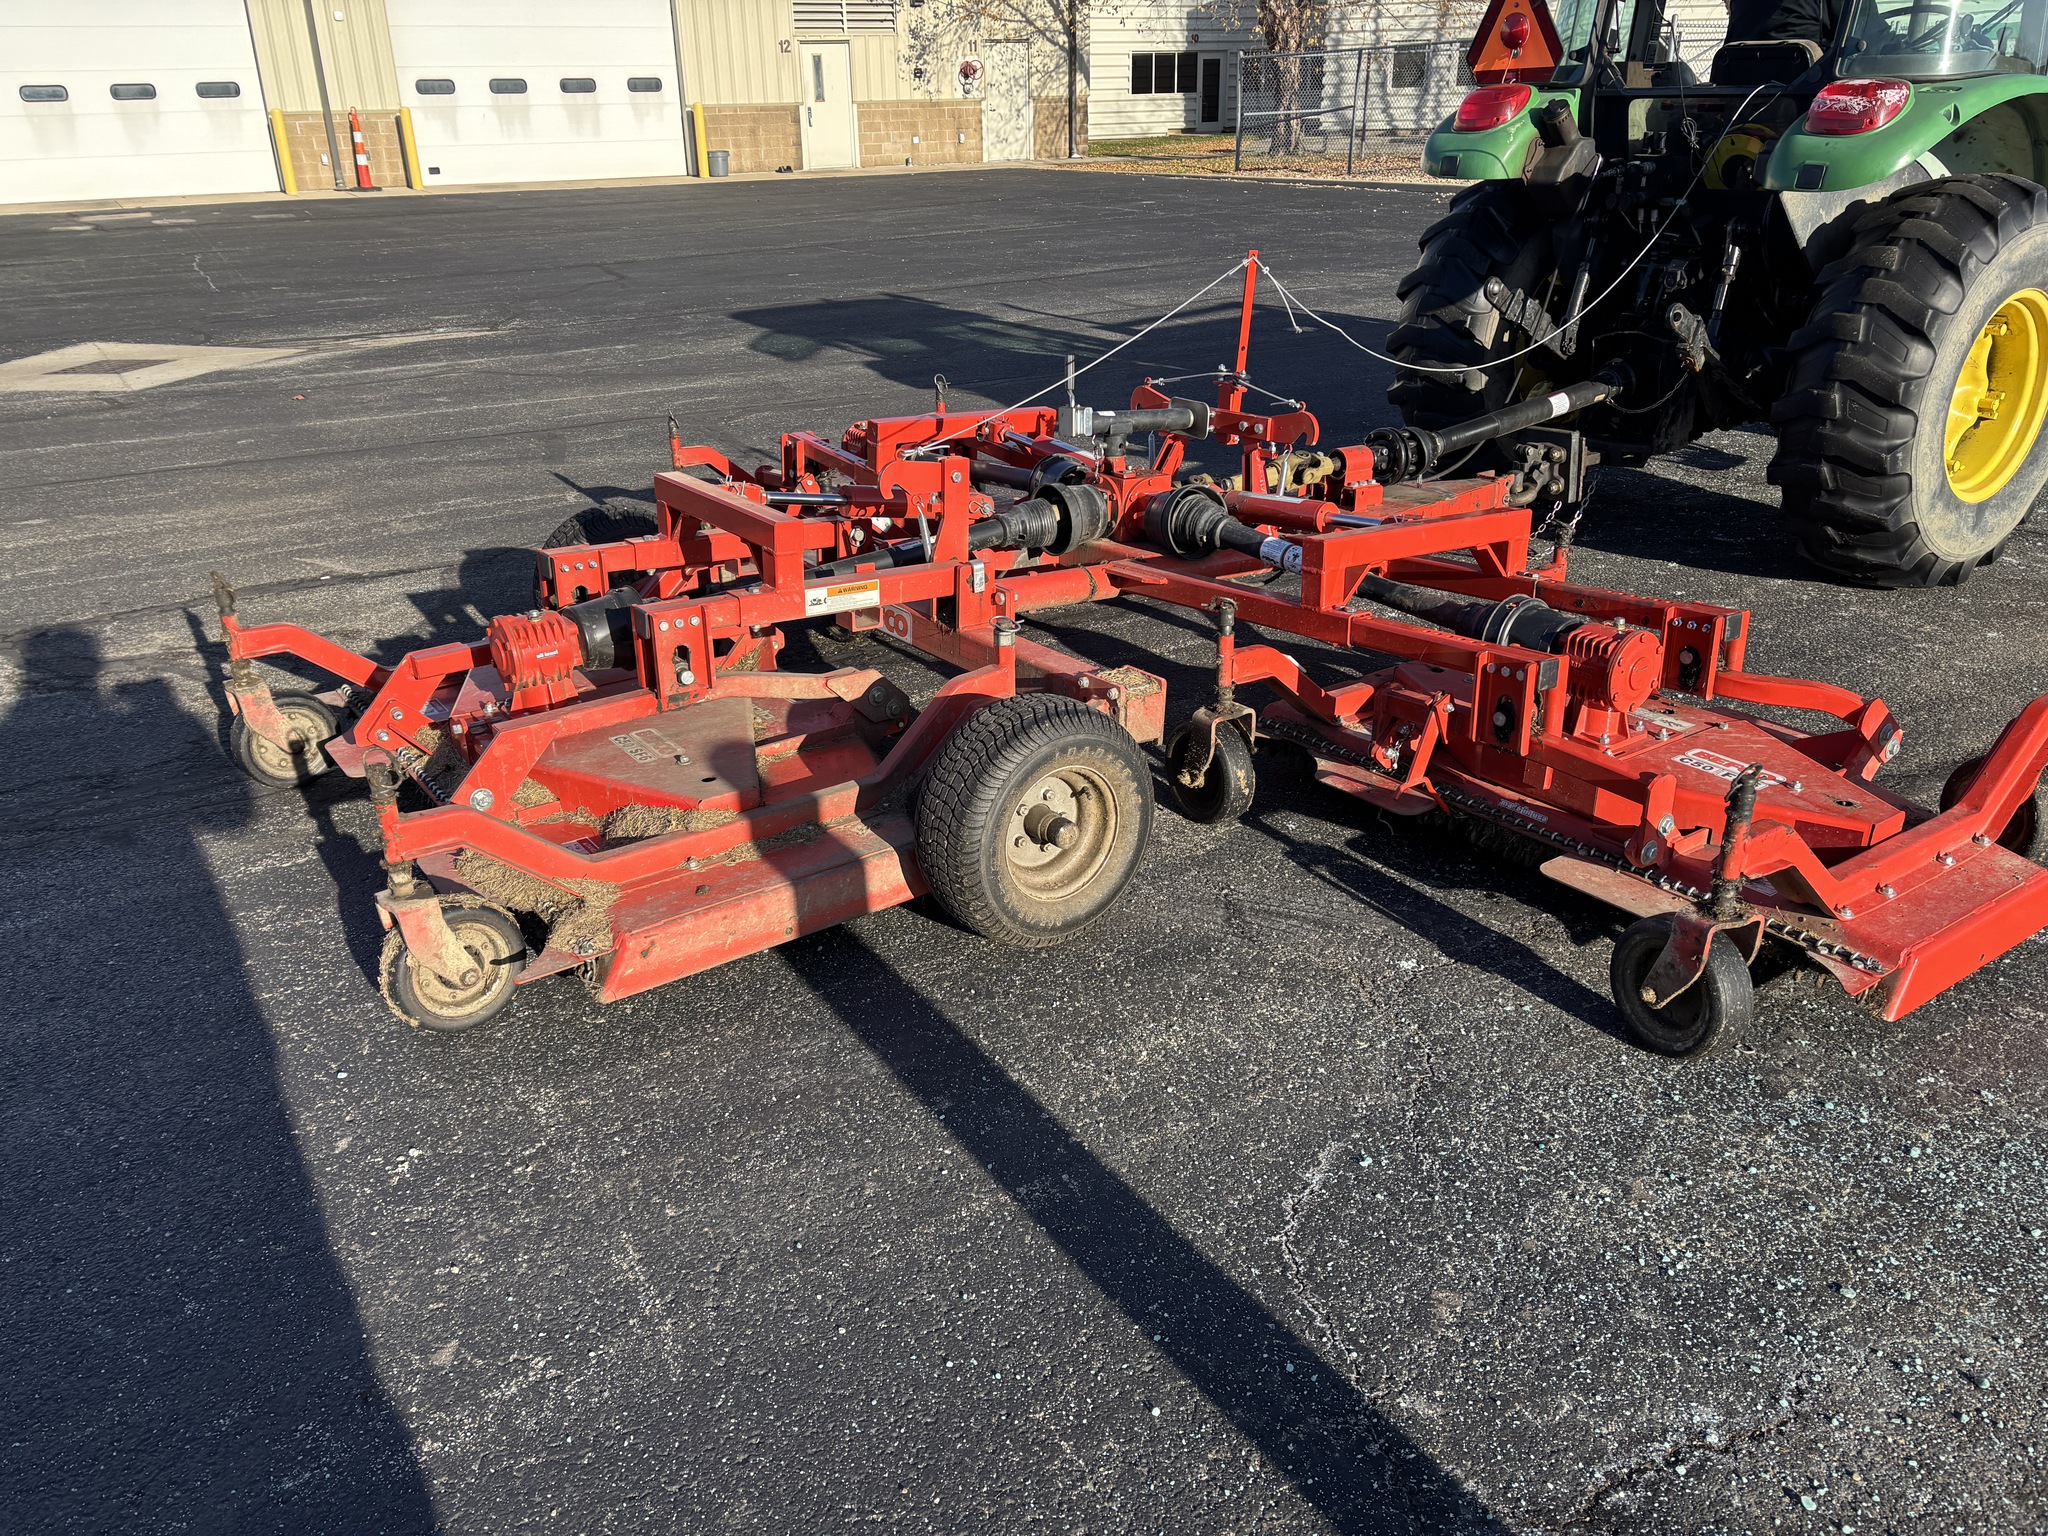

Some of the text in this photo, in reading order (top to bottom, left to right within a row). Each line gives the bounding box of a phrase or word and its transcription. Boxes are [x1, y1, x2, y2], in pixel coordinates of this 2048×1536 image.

[778, 39, 791, 53] 12
[968, 39, 977, 52] 11
[842, 584, 868, 593] WARNING
[629, 748, 652, 761] SF6
[1680, 758, 1714, 771] C50
